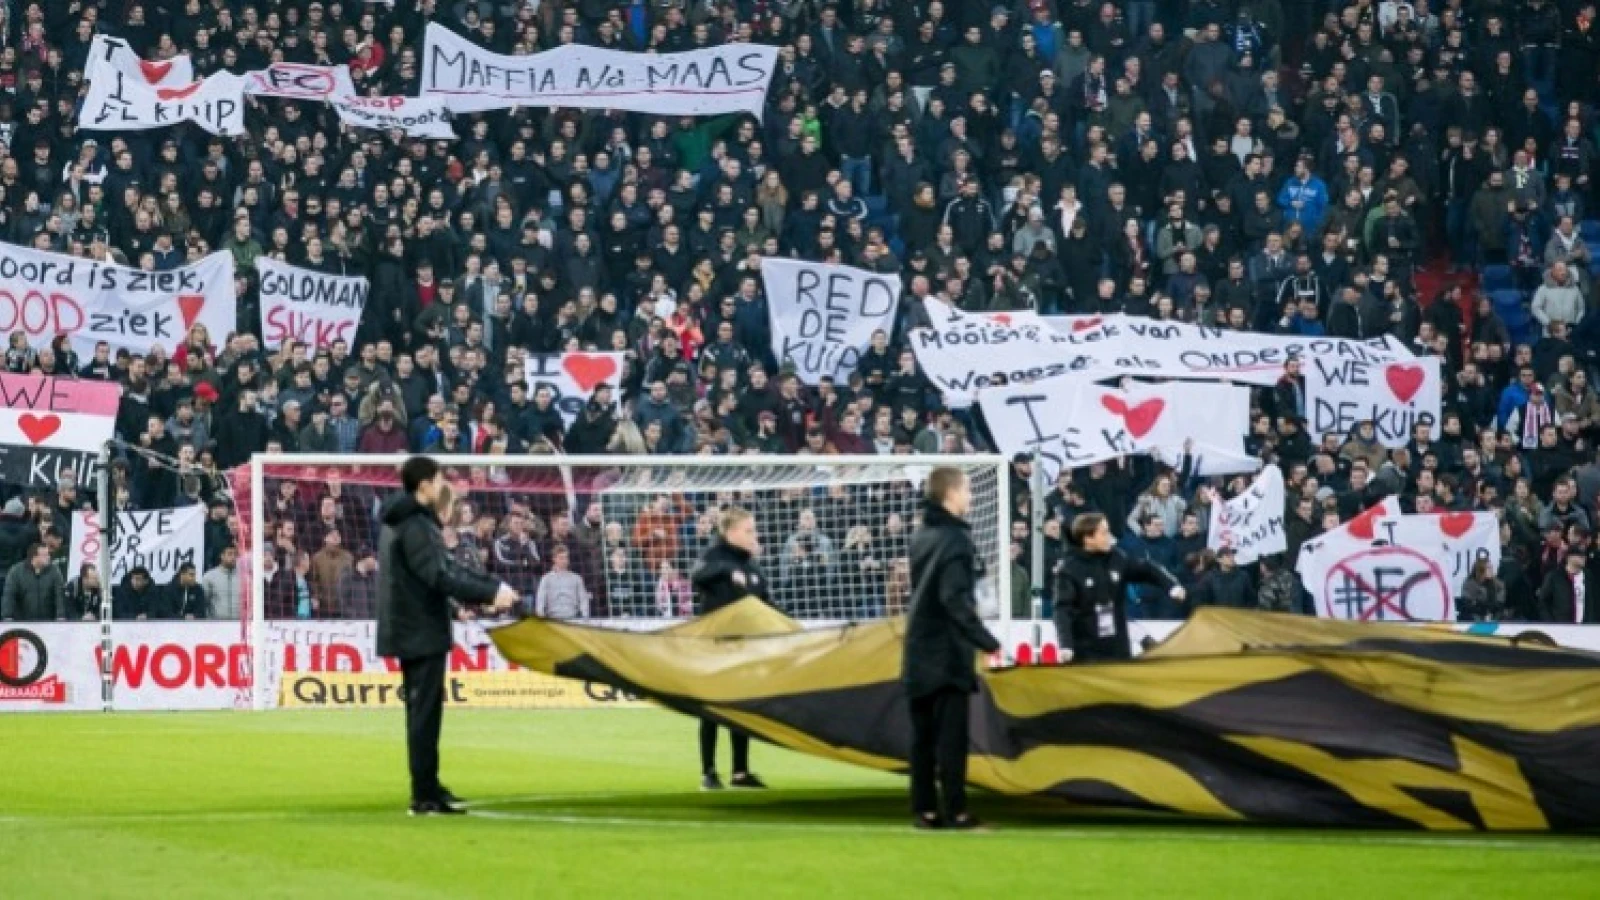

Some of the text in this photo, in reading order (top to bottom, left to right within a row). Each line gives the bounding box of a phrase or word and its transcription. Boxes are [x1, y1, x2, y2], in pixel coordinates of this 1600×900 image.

[648, 52, 767, 91] MAAS
[88, 264, 117, 291] is
[261, 269, 369, 308] GOLDMAN
[796, 269, 894, 317] RED
[90, 310, 173, 338] ziek
[799, 308, 846, 344] DE
[530, 353, 561, 377] I
[1315, 355, 1371, 387] WE
[0, 374, 79, 413] WE
[1005, 394, 1061, 445] I
[1315, 397, 1359, 434] DE
